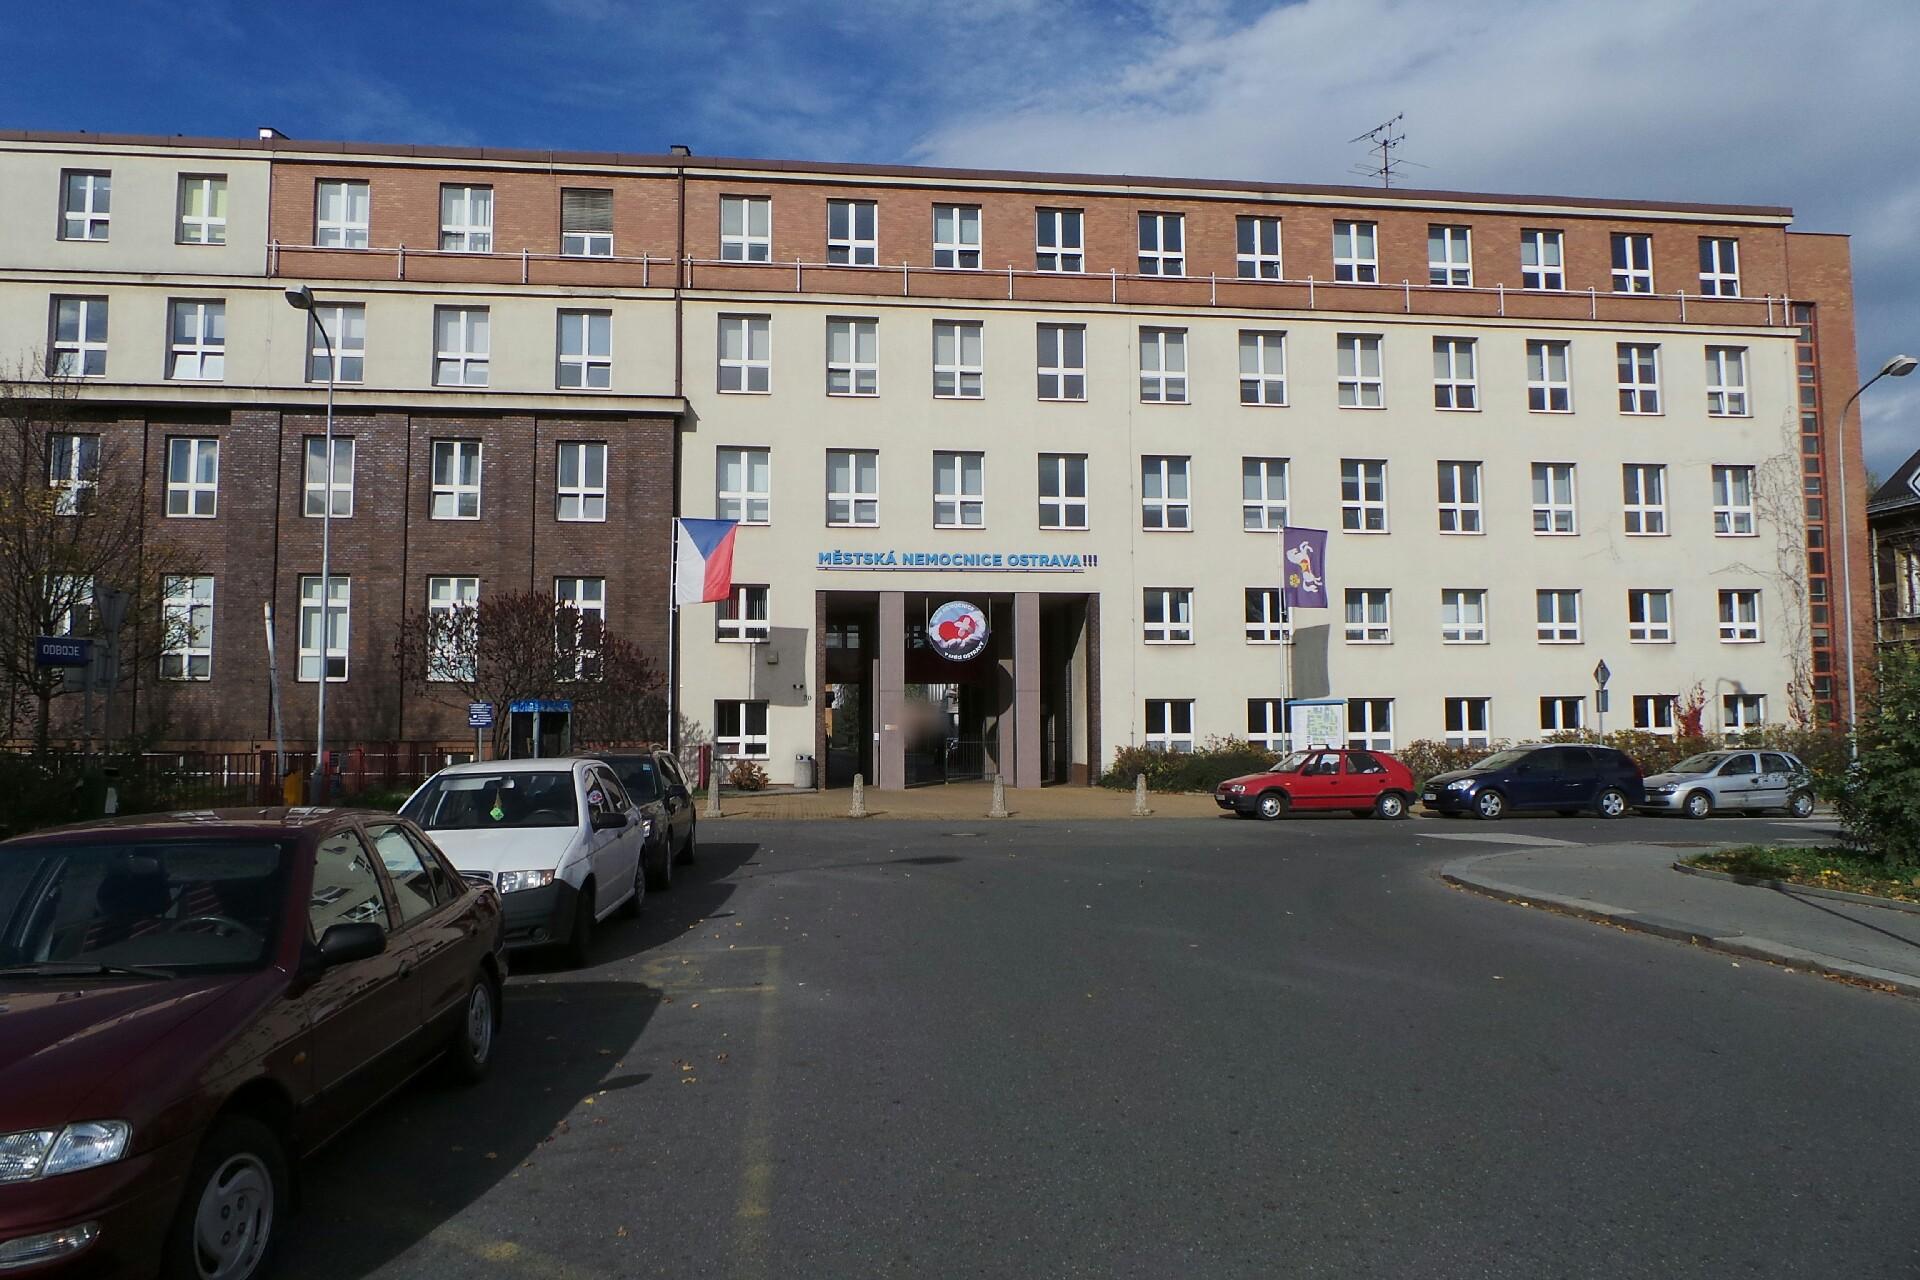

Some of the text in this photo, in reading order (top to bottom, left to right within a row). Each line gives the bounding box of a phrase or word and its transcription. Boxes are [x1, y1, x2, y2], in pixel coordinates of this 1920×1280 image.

[818, 550, 897, 566] MĚSTSKÁ
[902, 553, 1002, 567] NEMOCNICE
[43, 644, 80, 656] ODBOJE
